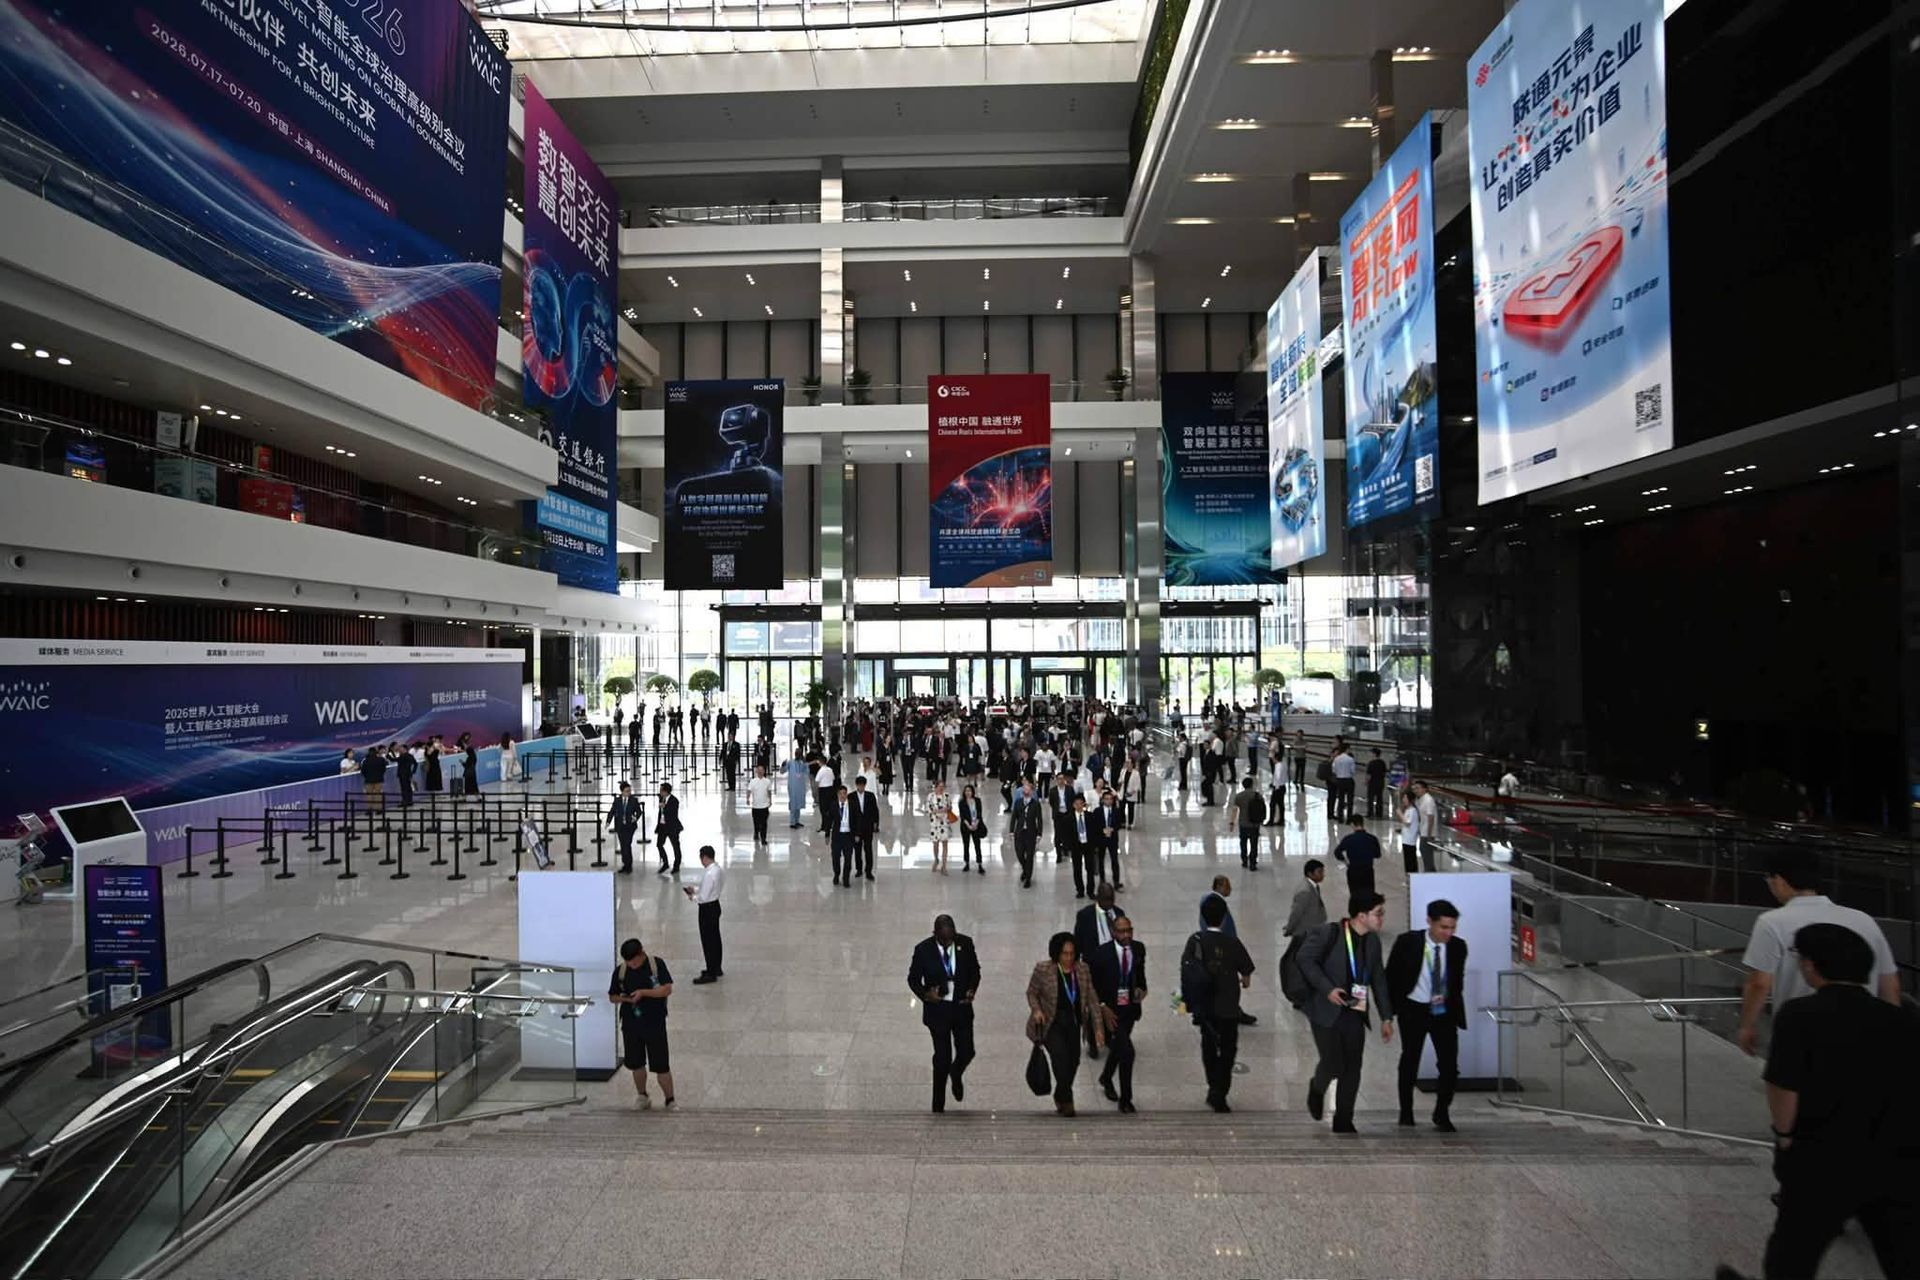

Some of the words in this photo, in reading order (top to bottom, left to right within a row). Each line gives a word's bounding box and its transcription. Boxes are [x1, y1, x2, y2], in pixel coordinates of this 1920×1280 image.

[345, 0, 405, 55] 26
[151, 24, 261, 113] 2026.07.17-07.20
[225, 0, 286, 47] 伙伴
[297, 41, 376, 130] 共创未来
[311, 21, 355, 71] MEETING
[357, 67, 372, 87] ON
[373, 83, 405, 120] GLOBAL
[407, 114, 416, 129] AI
[416, 123, 464, 175] GOVERNANCE
[469, 45, 500, 94] WAIC
[1512, 24, 1595, 127] 联通元景
[272, 54, 292, 79] FOR
[294, 75, 302, 87] A
[303, 81, 345, 126] BRIGHTER
[346, 118, 375, 149] FUTURE
[538, 127, 610, 238] 数智交行
[1498, 82, 1620, 212] 创造真实价值
[538, 169, 610, 277] 慧创未来
[1352, 193, 1419, 299] 智传网
[1352, 288, 1368, 328] AI
[938, 416, 979, 427] 植根中国
[982, 415, 1022, 426] 融通世界
[1183, 425, 1264, 437] 双向赋能促发展
[1183, 437, 1265, 449] 智联能源创未来
[73, 648, 96, 656] MEDIA
[97, 648, 124, 656] SERVICE
[165, 702, 259, 719] 2026世界人工智能大会
[314, 698, 369, 725] WAIC
[371, 694, 413, 720] 2026
